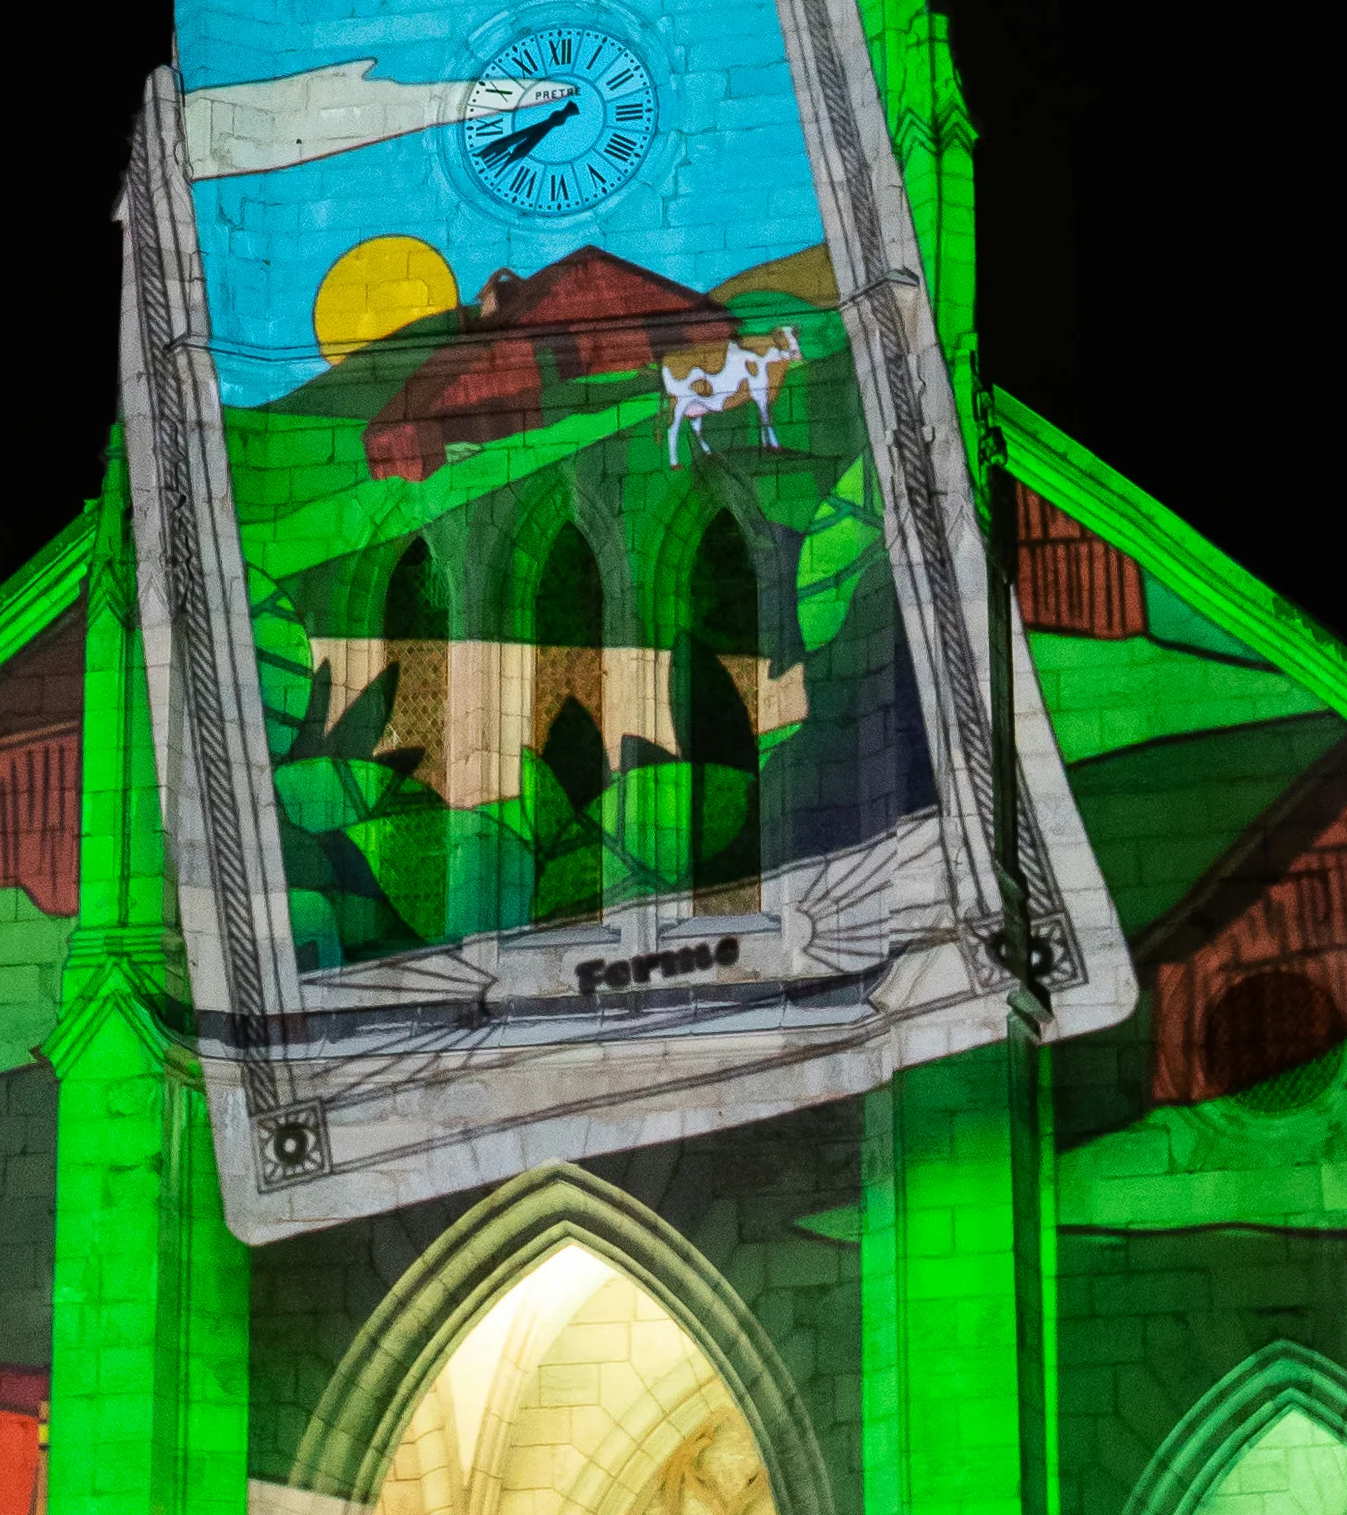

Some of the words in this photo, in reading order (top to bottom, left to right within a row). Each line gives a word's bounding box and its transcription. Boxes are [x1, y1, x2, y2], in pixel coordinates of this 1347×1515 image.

[512, 49, 539, 79] XI
[549, 38, 572, 67] XII
[586, 44, 603, 70] I
[485, 81, 513, 102] X
[606, 68, 635, 91] II
[615, 103, 643, 122] III
[475, 118, 503, 137] IX
[604, 133, 638, 162] IIII
[509, 165, 538, 199] VII
[551, 174, 569, 201] VI
[586, 162, 607, 189] V
[575, 935, 740, 995] Ferme
